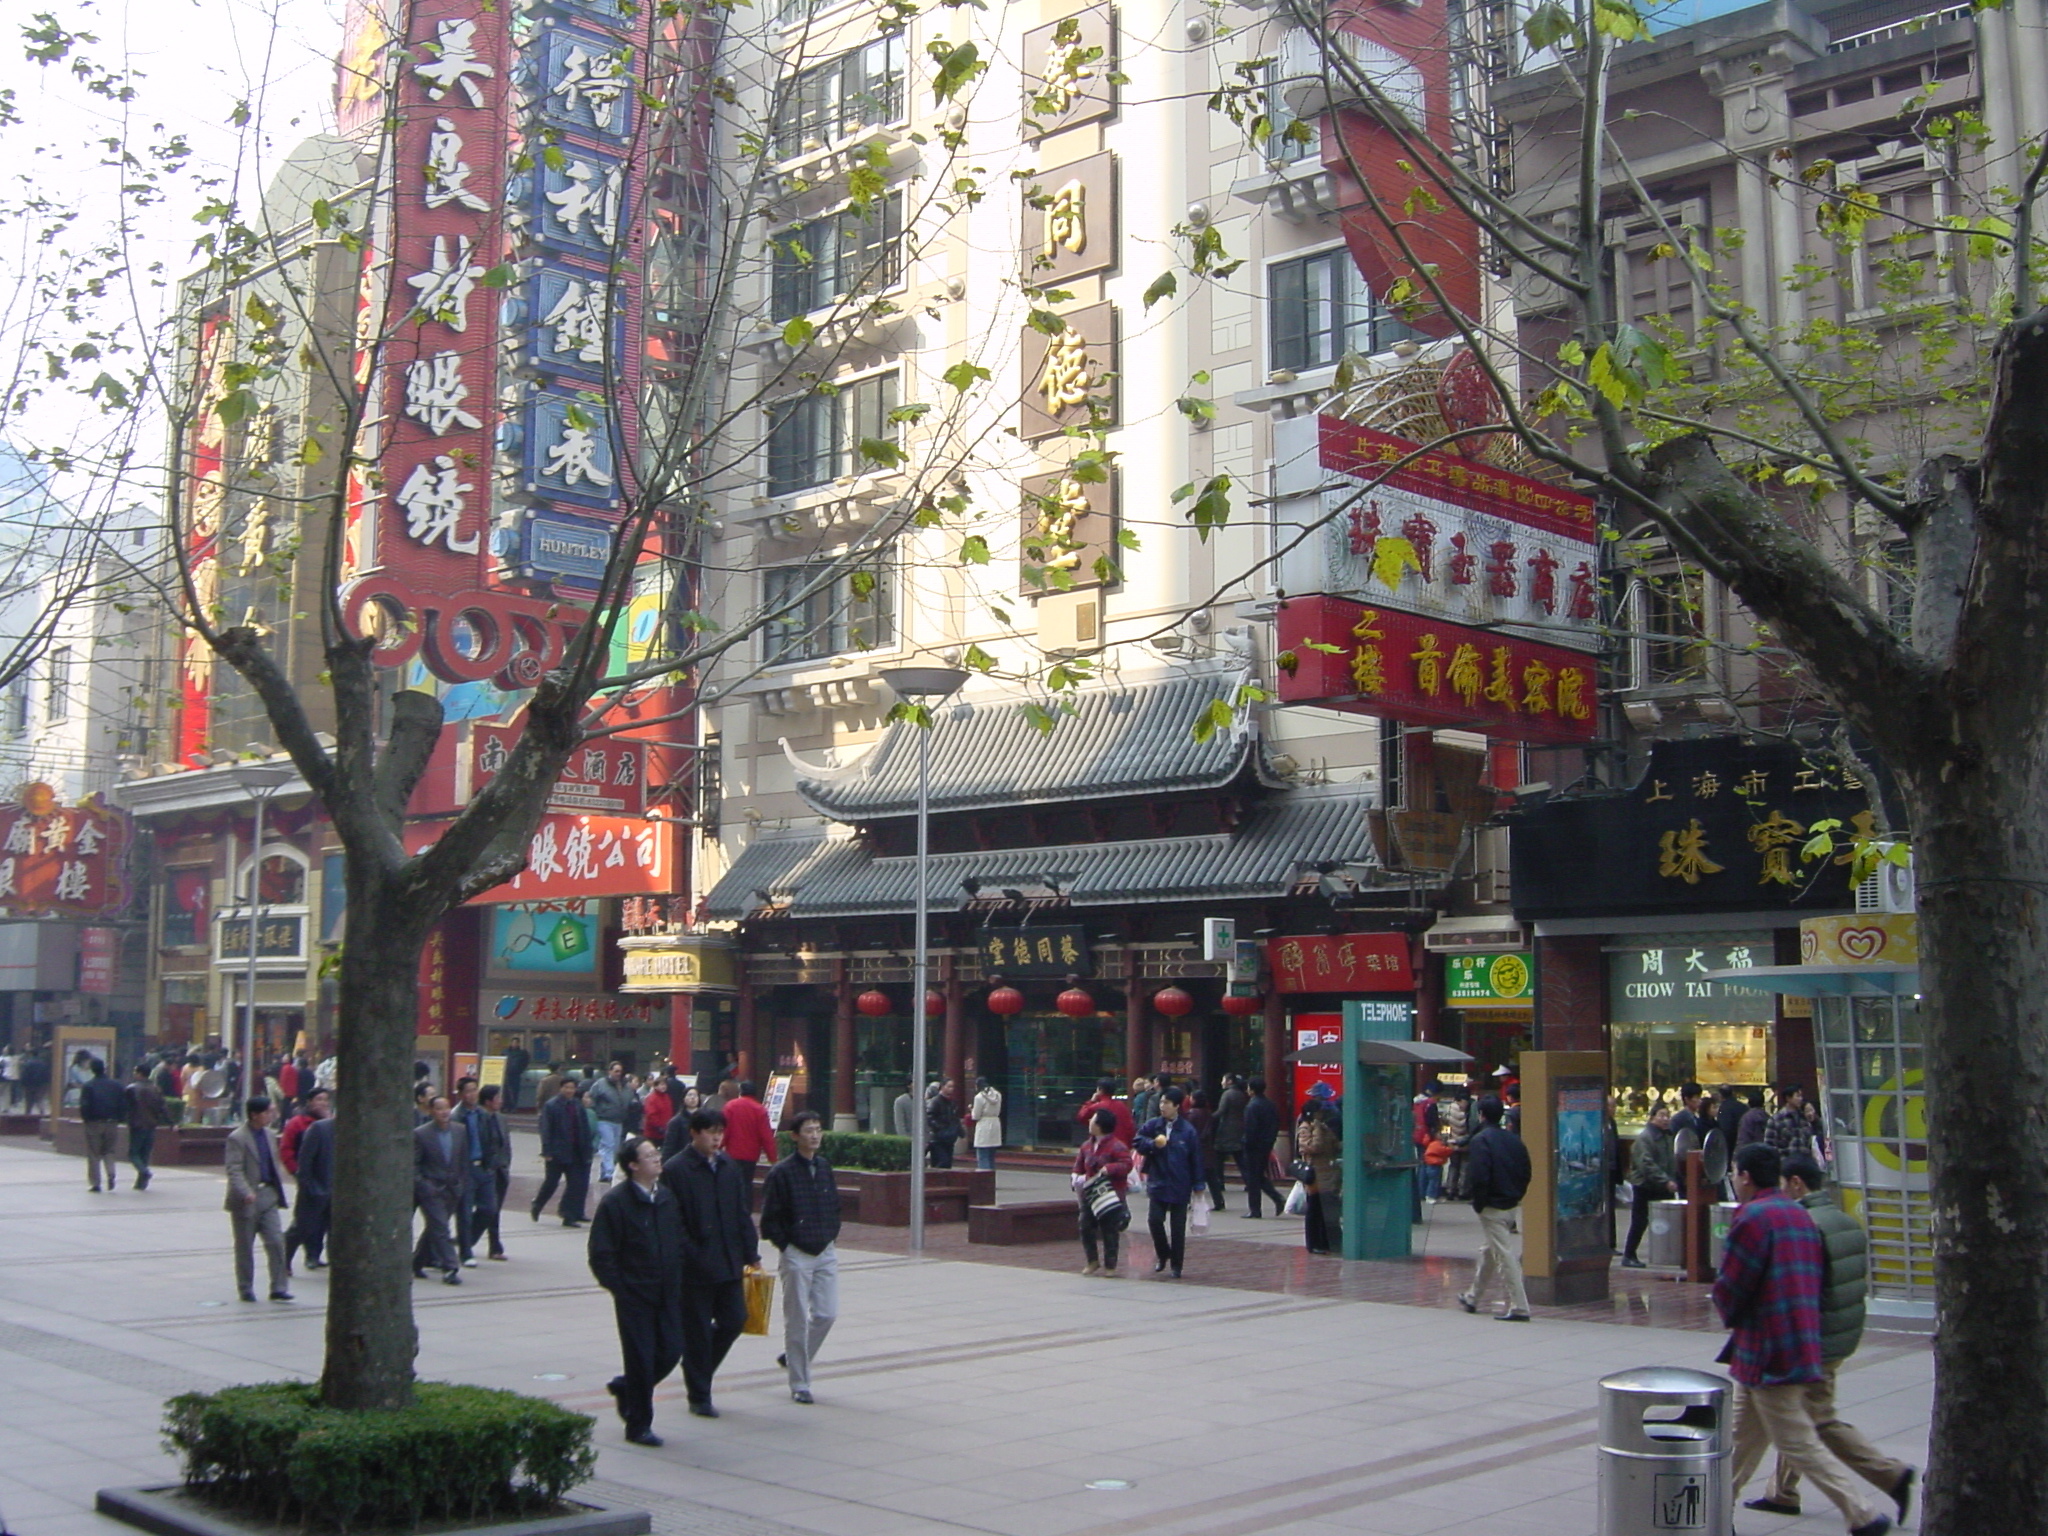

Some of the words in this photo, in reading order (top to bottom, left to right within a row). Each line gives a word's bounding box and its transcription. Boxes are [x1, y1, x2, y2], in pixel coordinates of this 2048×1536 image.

[539, 537, 608, 562] HUNTLEY
[479, 734, 637, 786] 南酒店
[562, 930, 577, 951] E
[1641, 946, 1753, 976] 周大福
[1625, 982, 1675, 998] CHOW
[1685, 982, 1712, 998] TAI
[1361, 1002, 1407, 1022] TELEPHONE
